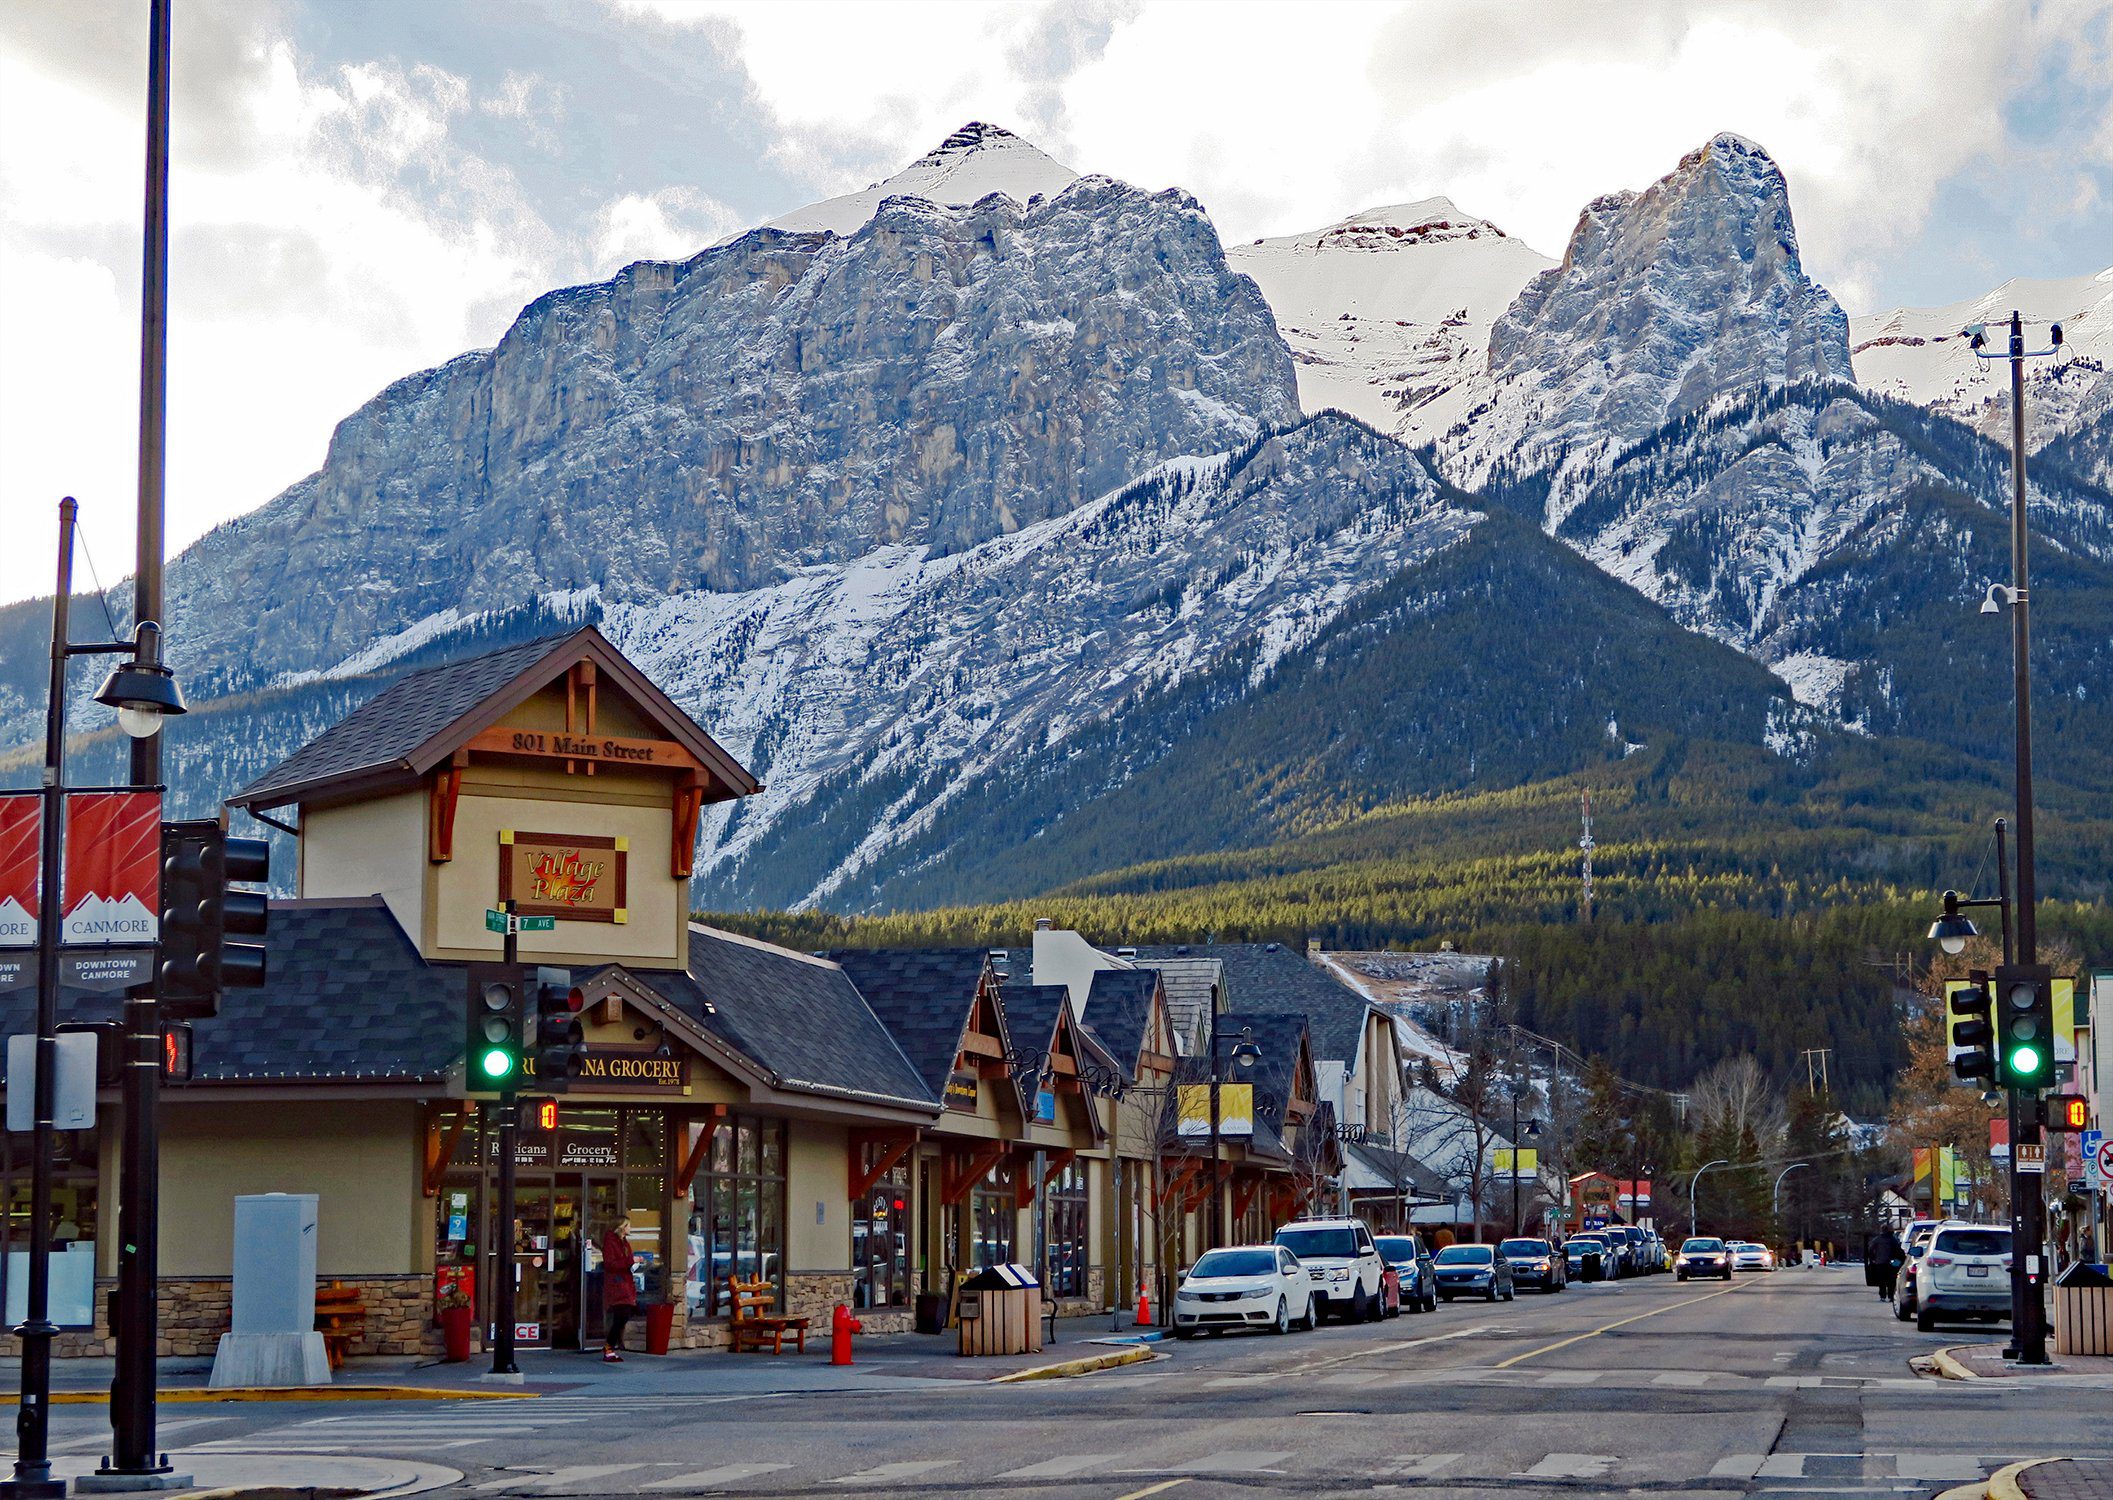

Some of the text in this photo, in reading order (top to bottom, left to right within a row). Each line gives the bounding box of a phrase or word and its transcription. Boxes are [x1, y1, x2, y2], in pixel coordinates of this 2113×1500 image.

[513, 733, 653, 761] 801 Main Street
[525, 849, 604, 885] Village
[531, 877, 595, 902] Plaza
[0, 922, 29, 936] ORE
[71, 919, 149, 935] CANMORE
[523, 918, 550, 929] 7 AVE
[75, 959, 137, 970] DOWNTOWN
[81, 970, 130, 980] CANMORE
[610, 1059, 682, 1078] GROCERY
[541, 1104, 555, 1129] 10
[2070, 1101, 2085, 1126] 10
[491, 1142, 547, 1154] Ricana
[566, 1143, 611, 1156] Grocery
[515, 1326, 538, 1339] CE
